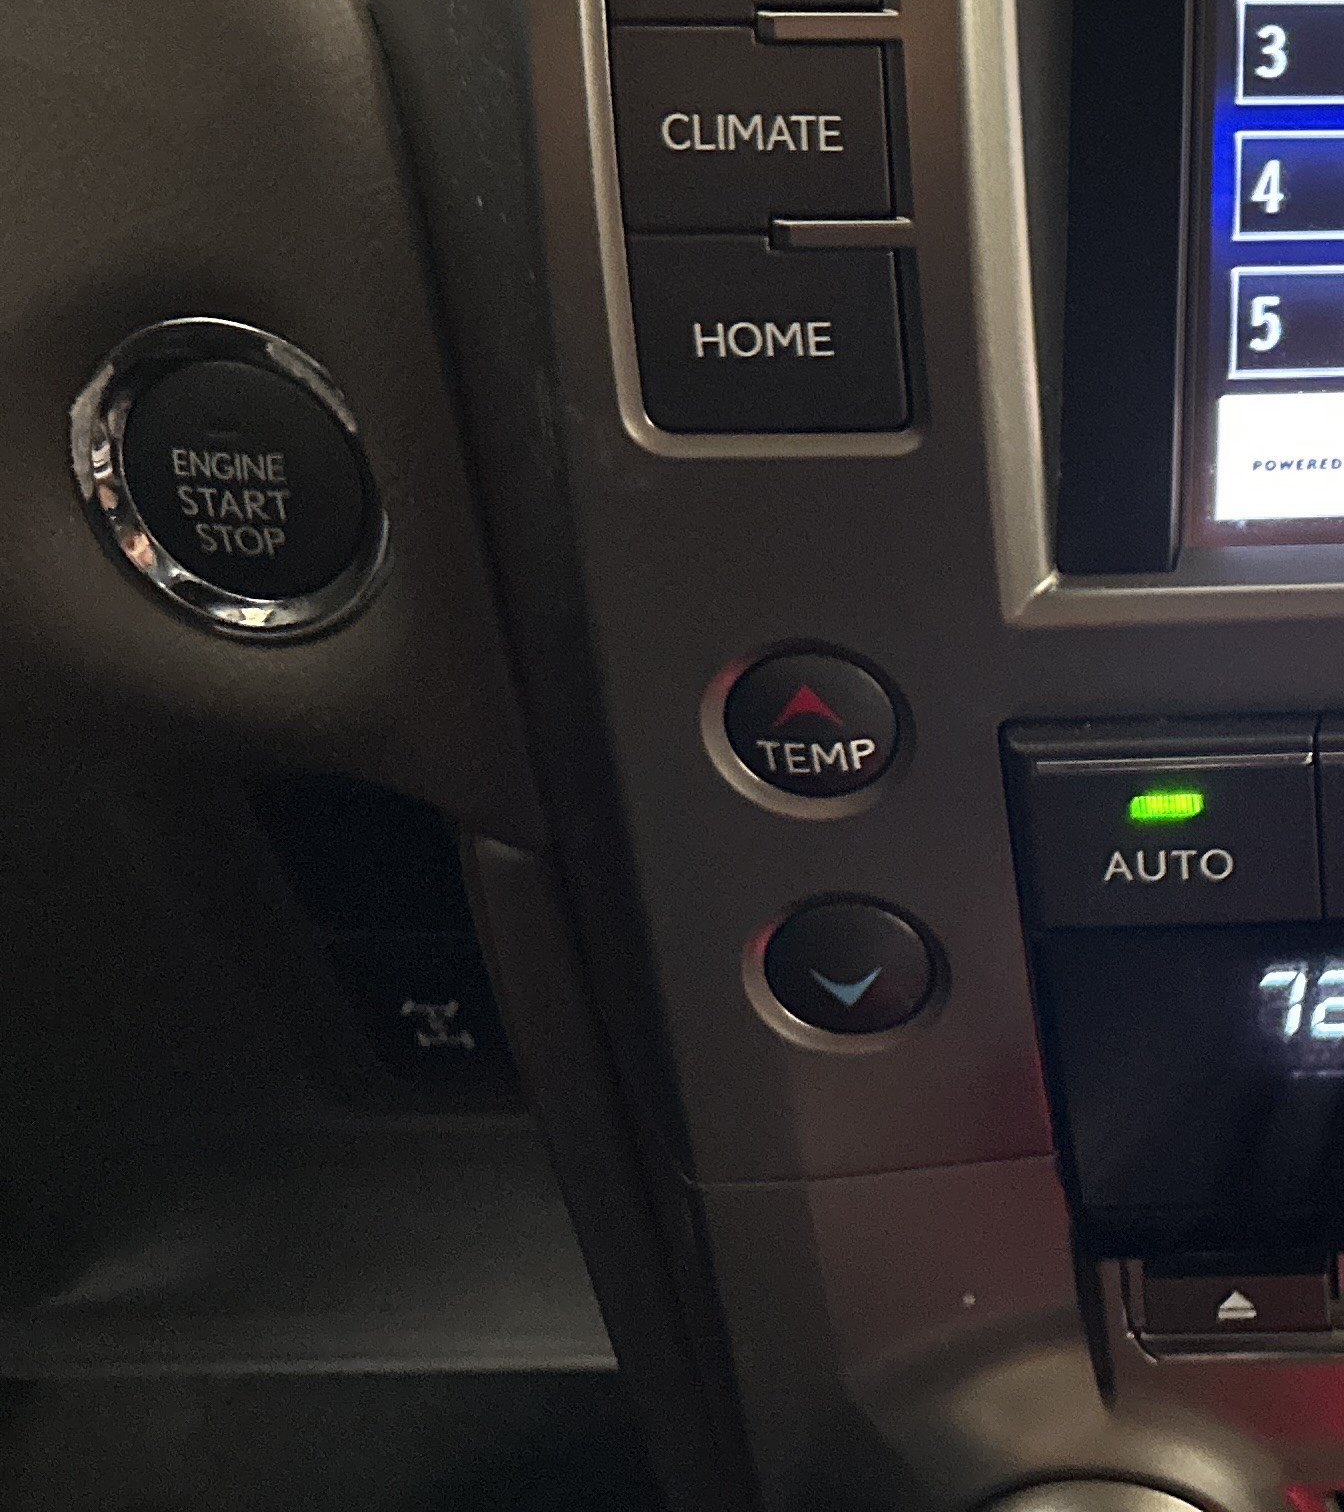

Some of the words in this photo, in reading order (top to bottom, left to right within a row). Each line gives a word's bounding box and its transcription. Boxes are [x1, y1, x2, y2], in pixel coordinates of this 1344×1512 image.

[1254, 23, 1289, 80] 3
[660, 112, 845, 153] CLIMATE
[1250, 159, 1285, 214] 4
[692, 320, 837, 359] HOME
[1248, 294, 1284, 353] 5
[170, 448, 288, 482] ENGINE
[1252, 457, 1343, 471] POWERED
[175, 487, 291, 523] START
[194, 522, 287, 557] STOP
[755, 737, 878, 774] TEMP
[1103, 848, 1235, 883] AUTO
